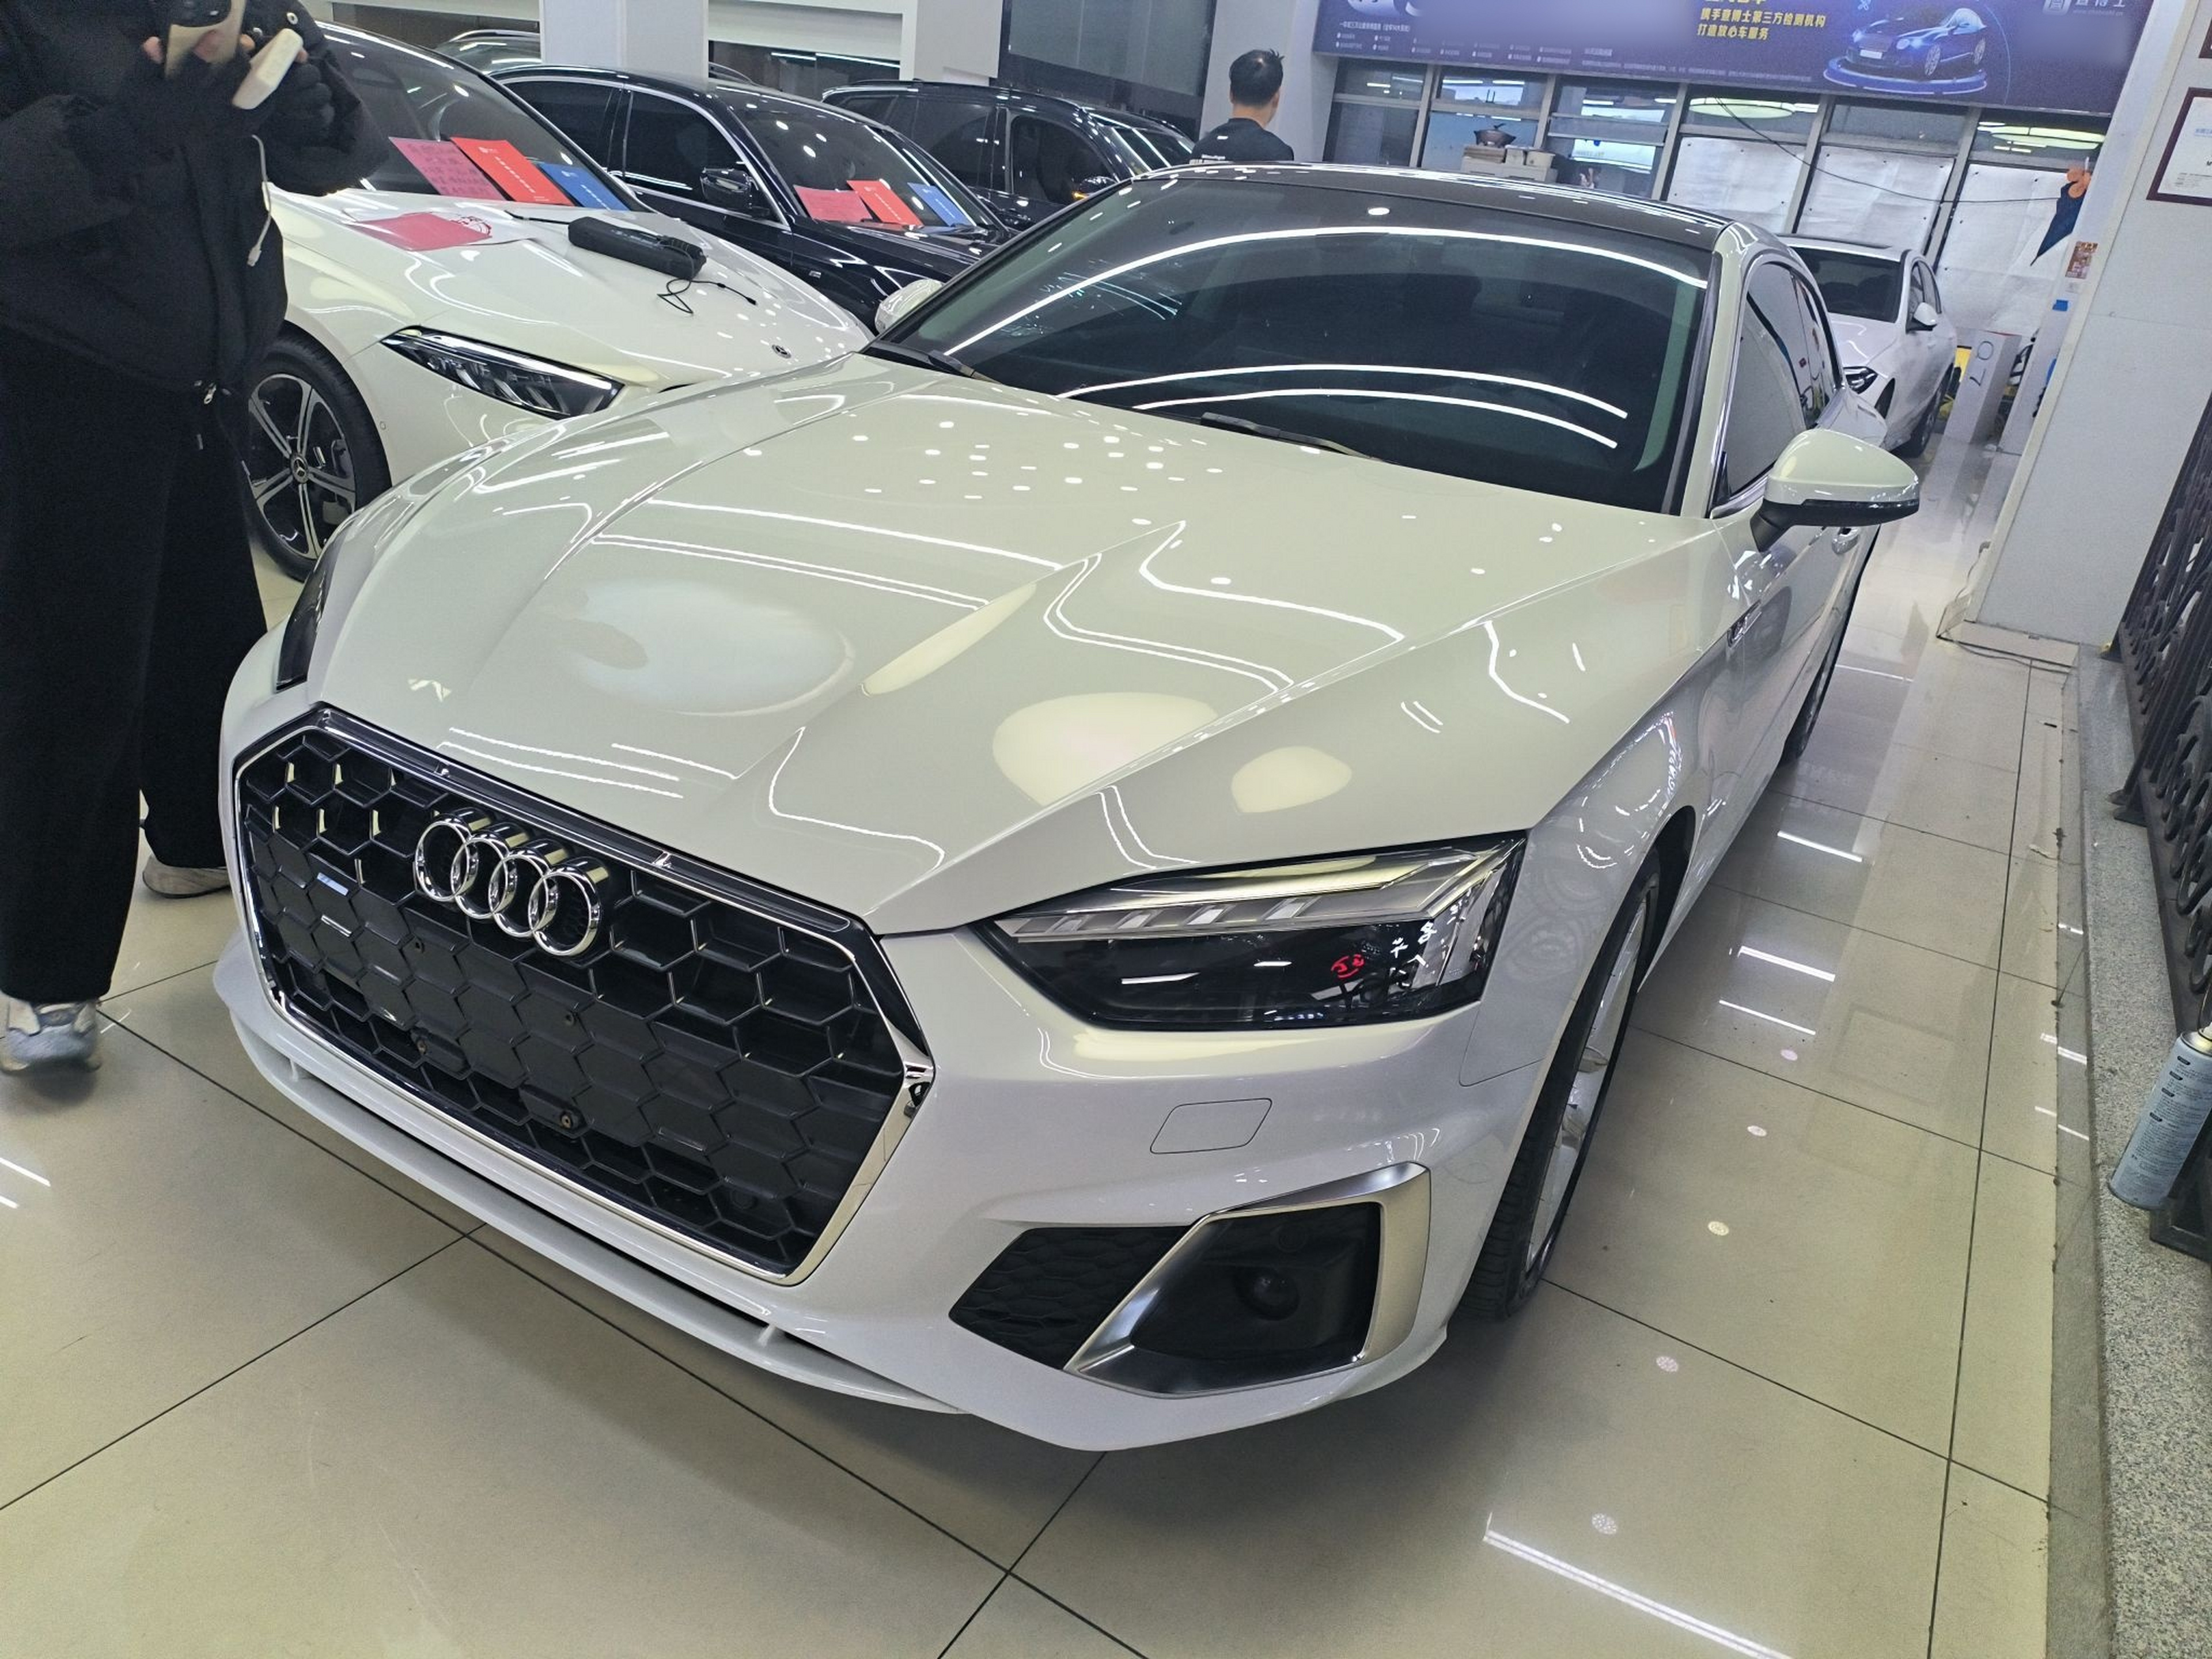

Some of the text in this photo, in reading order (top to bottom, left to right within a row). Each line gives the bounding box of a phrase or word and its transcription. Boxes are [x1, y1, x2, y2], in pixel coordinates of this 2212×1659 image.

[1696, 23, 1770, 40] 打造放心车服务
